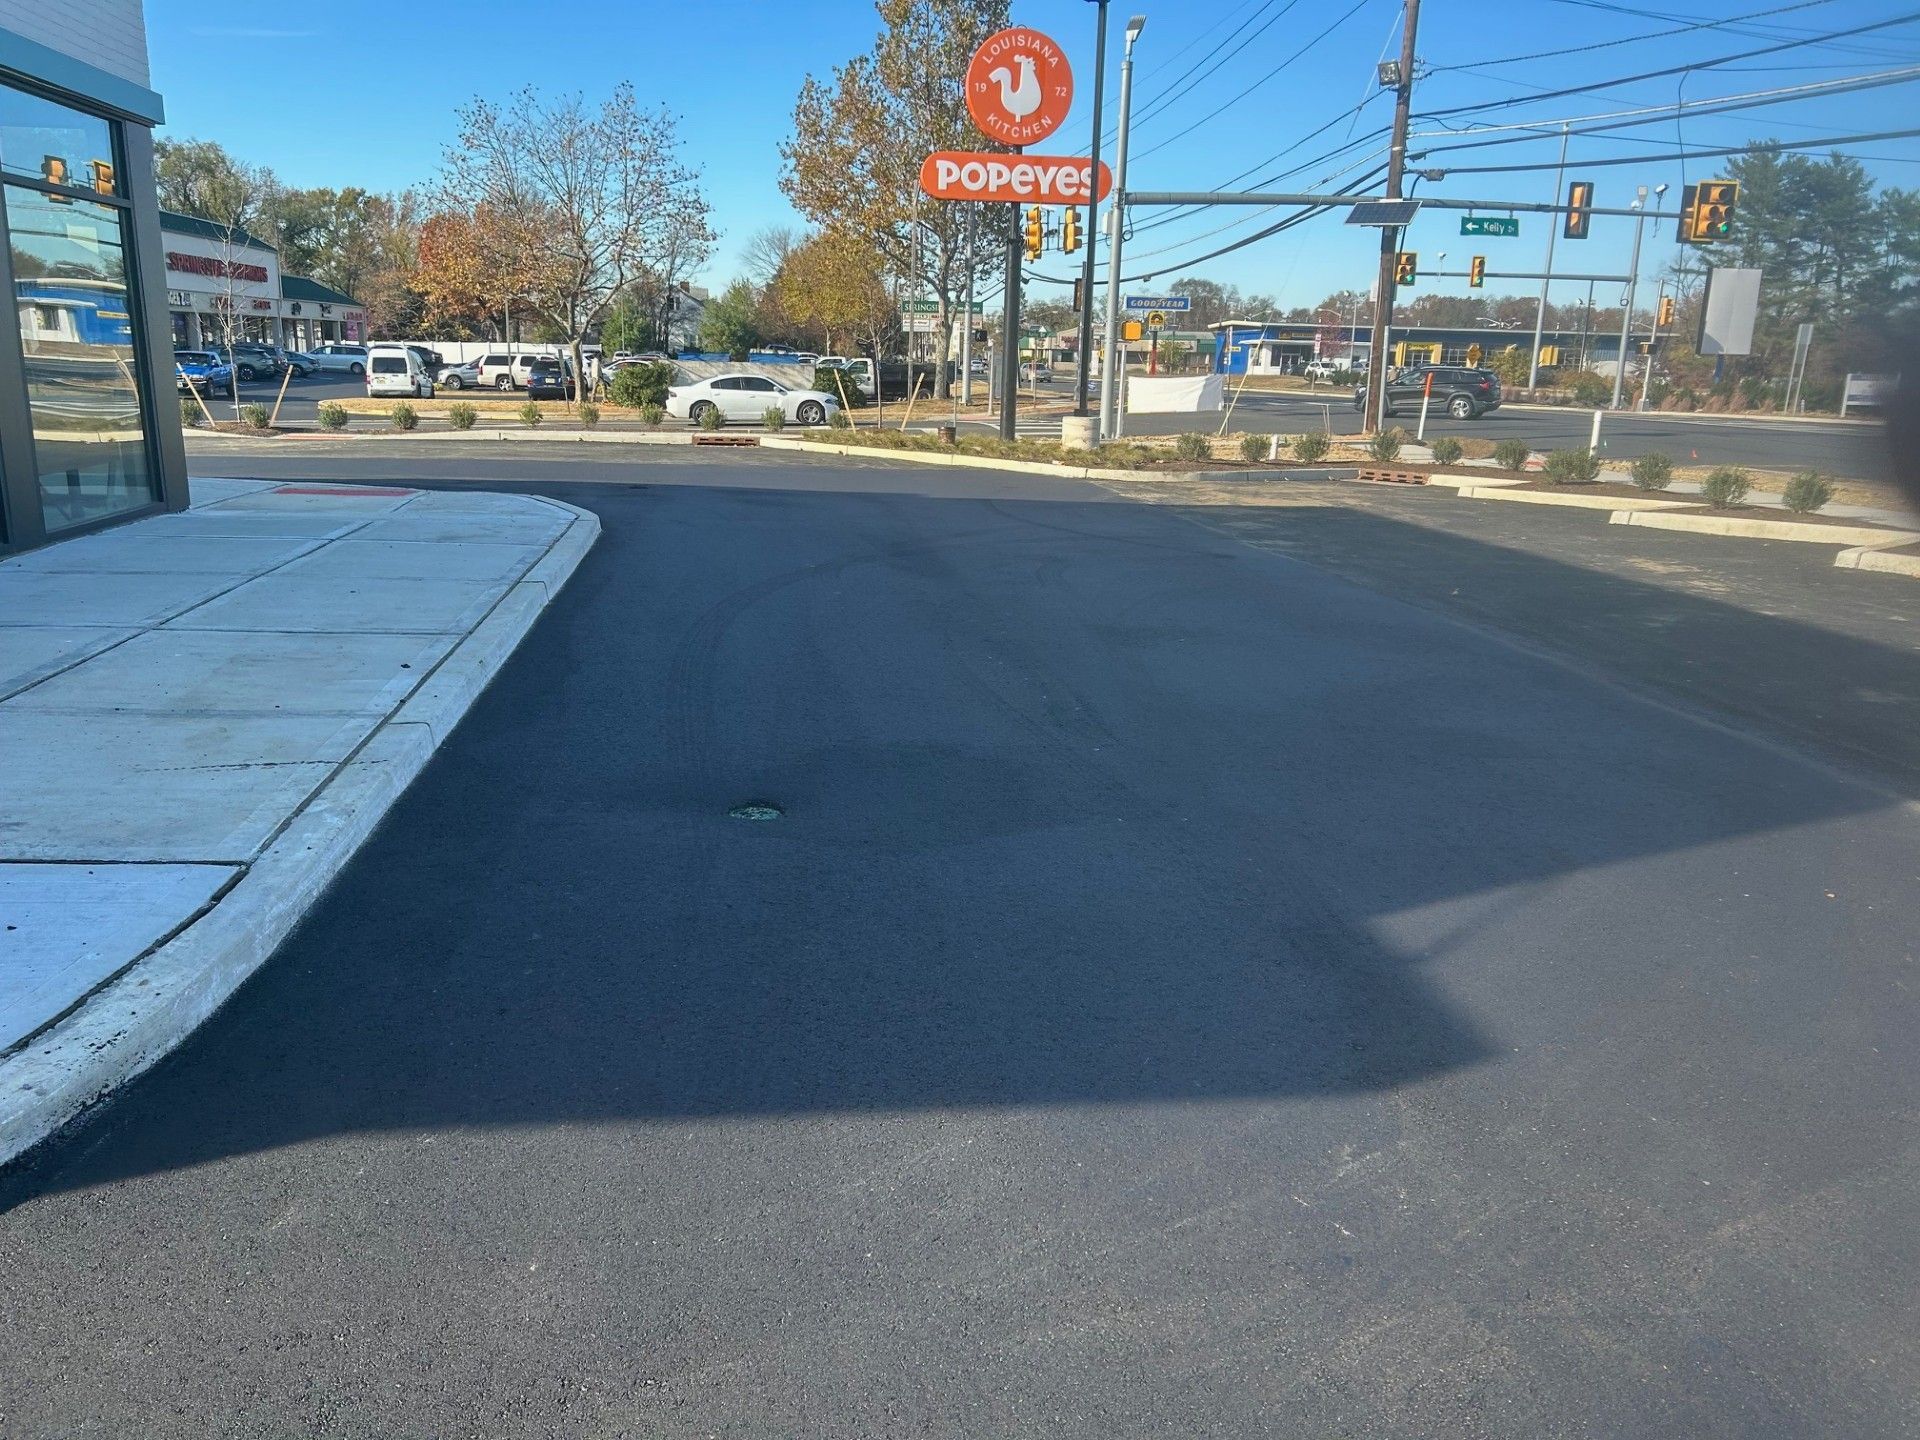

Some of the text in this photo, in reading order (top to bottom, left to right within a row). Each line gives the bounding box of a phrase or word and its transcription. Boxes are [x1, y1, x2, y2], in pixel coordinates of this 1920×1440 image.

[982, 34, 1060, 68] LOUISIANA
[975, 82, 1067, 97] 19 72
[986, 113, 1052, 138] KITCHEN
[1483, 221, 1505, 234] Kelly
[1130, 299, 1185, 308] GOODYEAR
